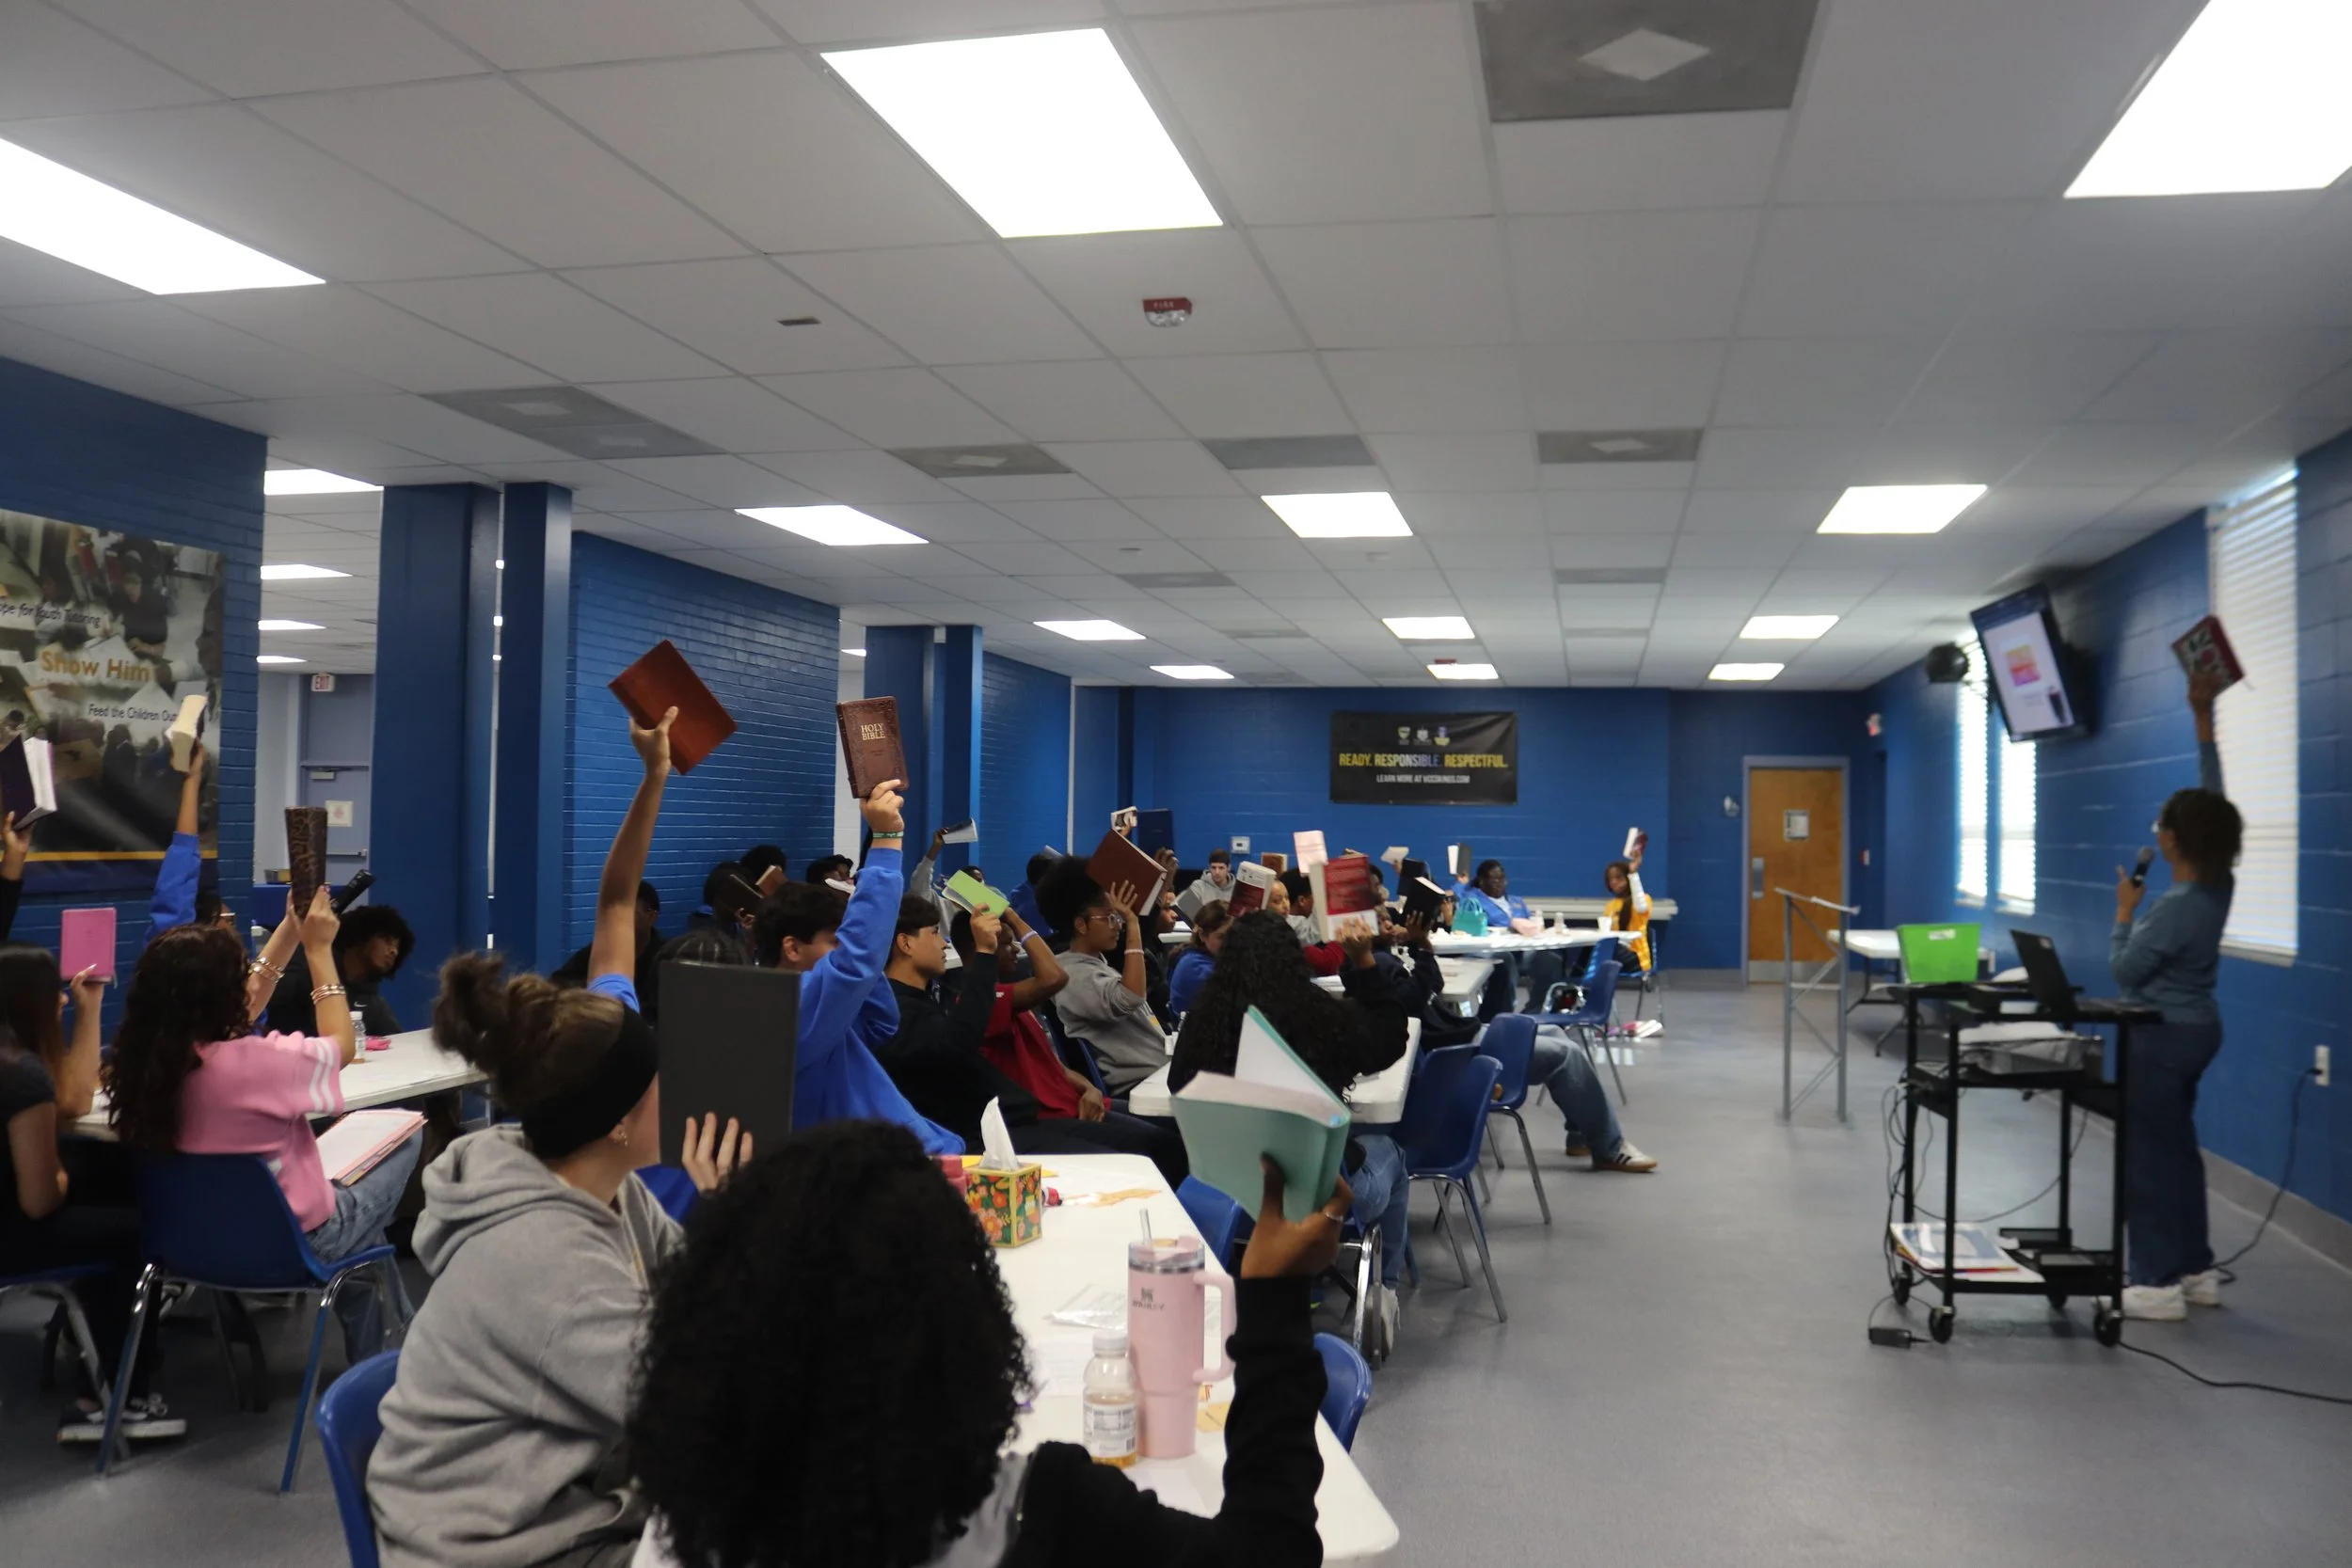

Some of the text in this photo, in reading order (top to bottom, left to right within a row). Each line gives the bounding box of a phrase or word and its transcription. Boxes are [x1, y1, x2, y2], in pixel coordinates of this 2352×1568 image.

[19, 603, 34, 617] for
[36, 605, 62, 621] Youth
[65, 609, 101, 628] Tutoring
[40, 650, 151, 683] Show Him
[315, 675, 330, 690] EXIT
[88, 704, 108, 718] Feed
[111, 706, 124, 720] the
[127, 707, 160, 721] Children
[860, 722, 883, 733] HOLY
[862, 731, 886, 741] BIBLE
[1339, 752, 1509, 768] READY. RESPONSIBLE. RESPECTFUL.
[1375, 773, 1396, 784] LEARN
[1397, 773, 1413, 784] MORE
[1414, 773, 1422, 784] AT
